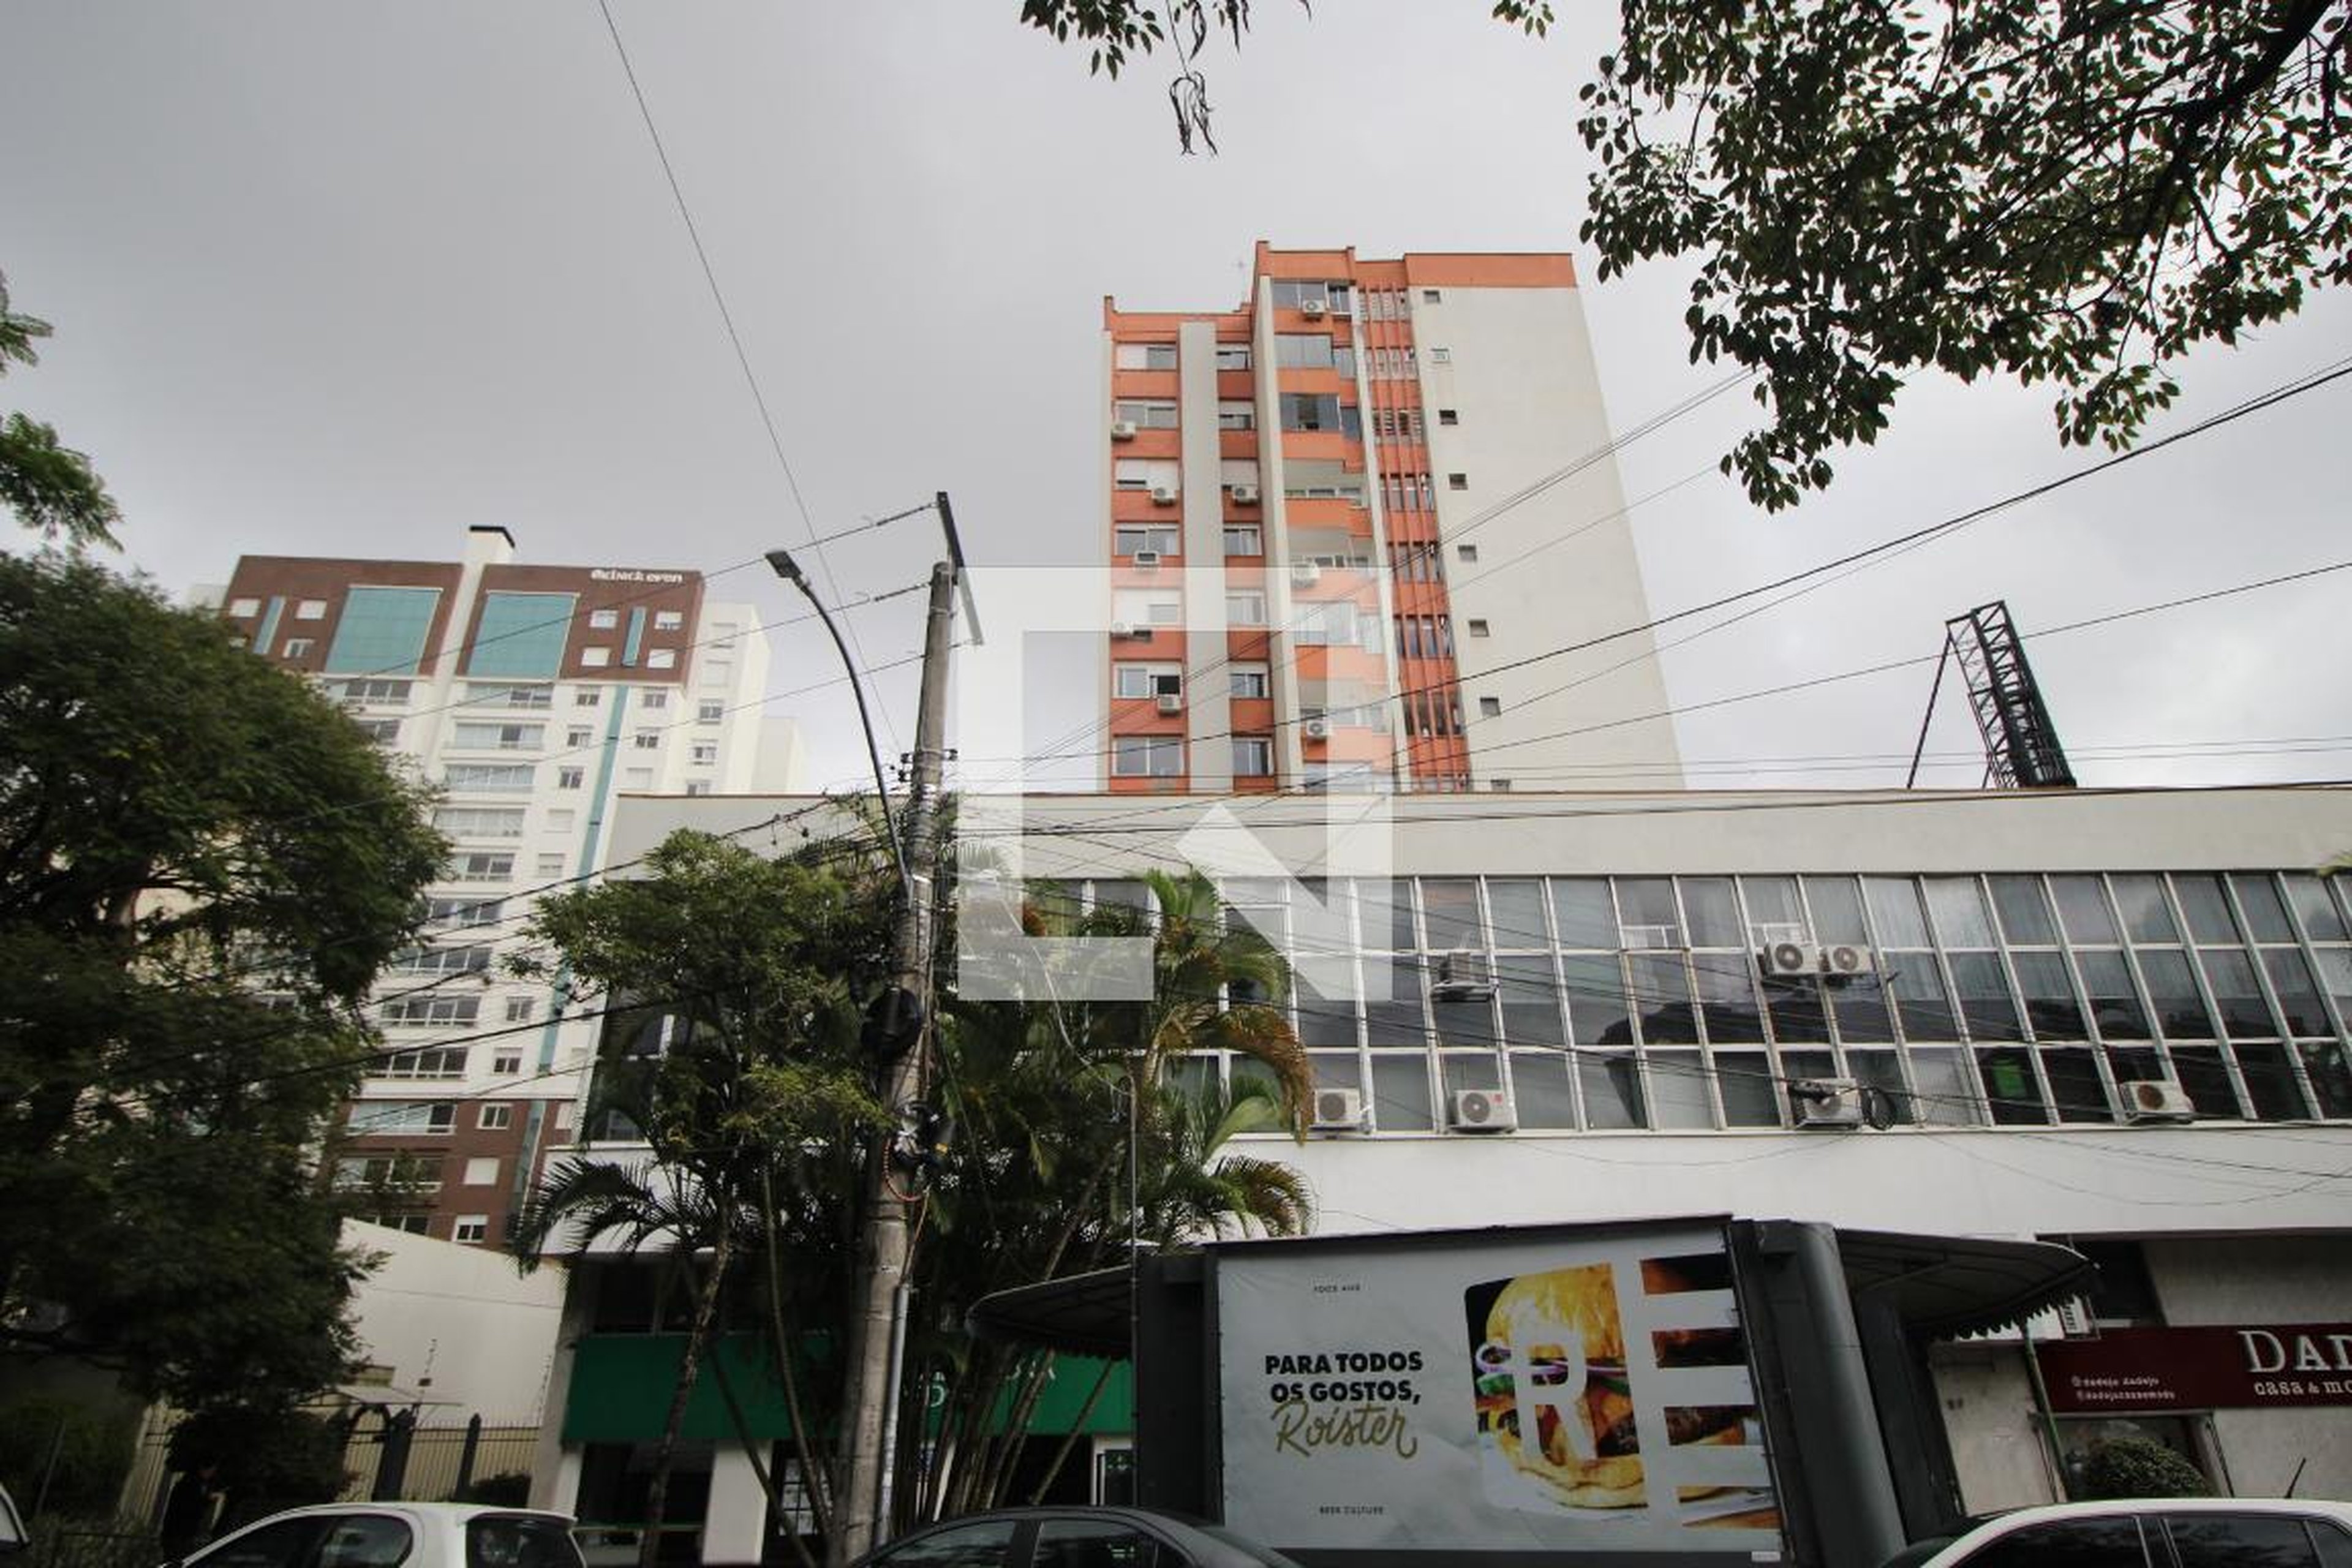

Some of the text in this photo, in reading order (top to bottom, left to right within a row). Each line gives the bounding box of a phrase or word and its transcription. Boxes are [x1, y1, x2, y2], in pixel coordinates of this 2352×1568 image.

[1265, 1351, 1423, 1374] PARA TODOS
[1270, 1380, 1421, 1405] OS GOSTOS,
[1270, 1398, 1417, 1459] Roister
